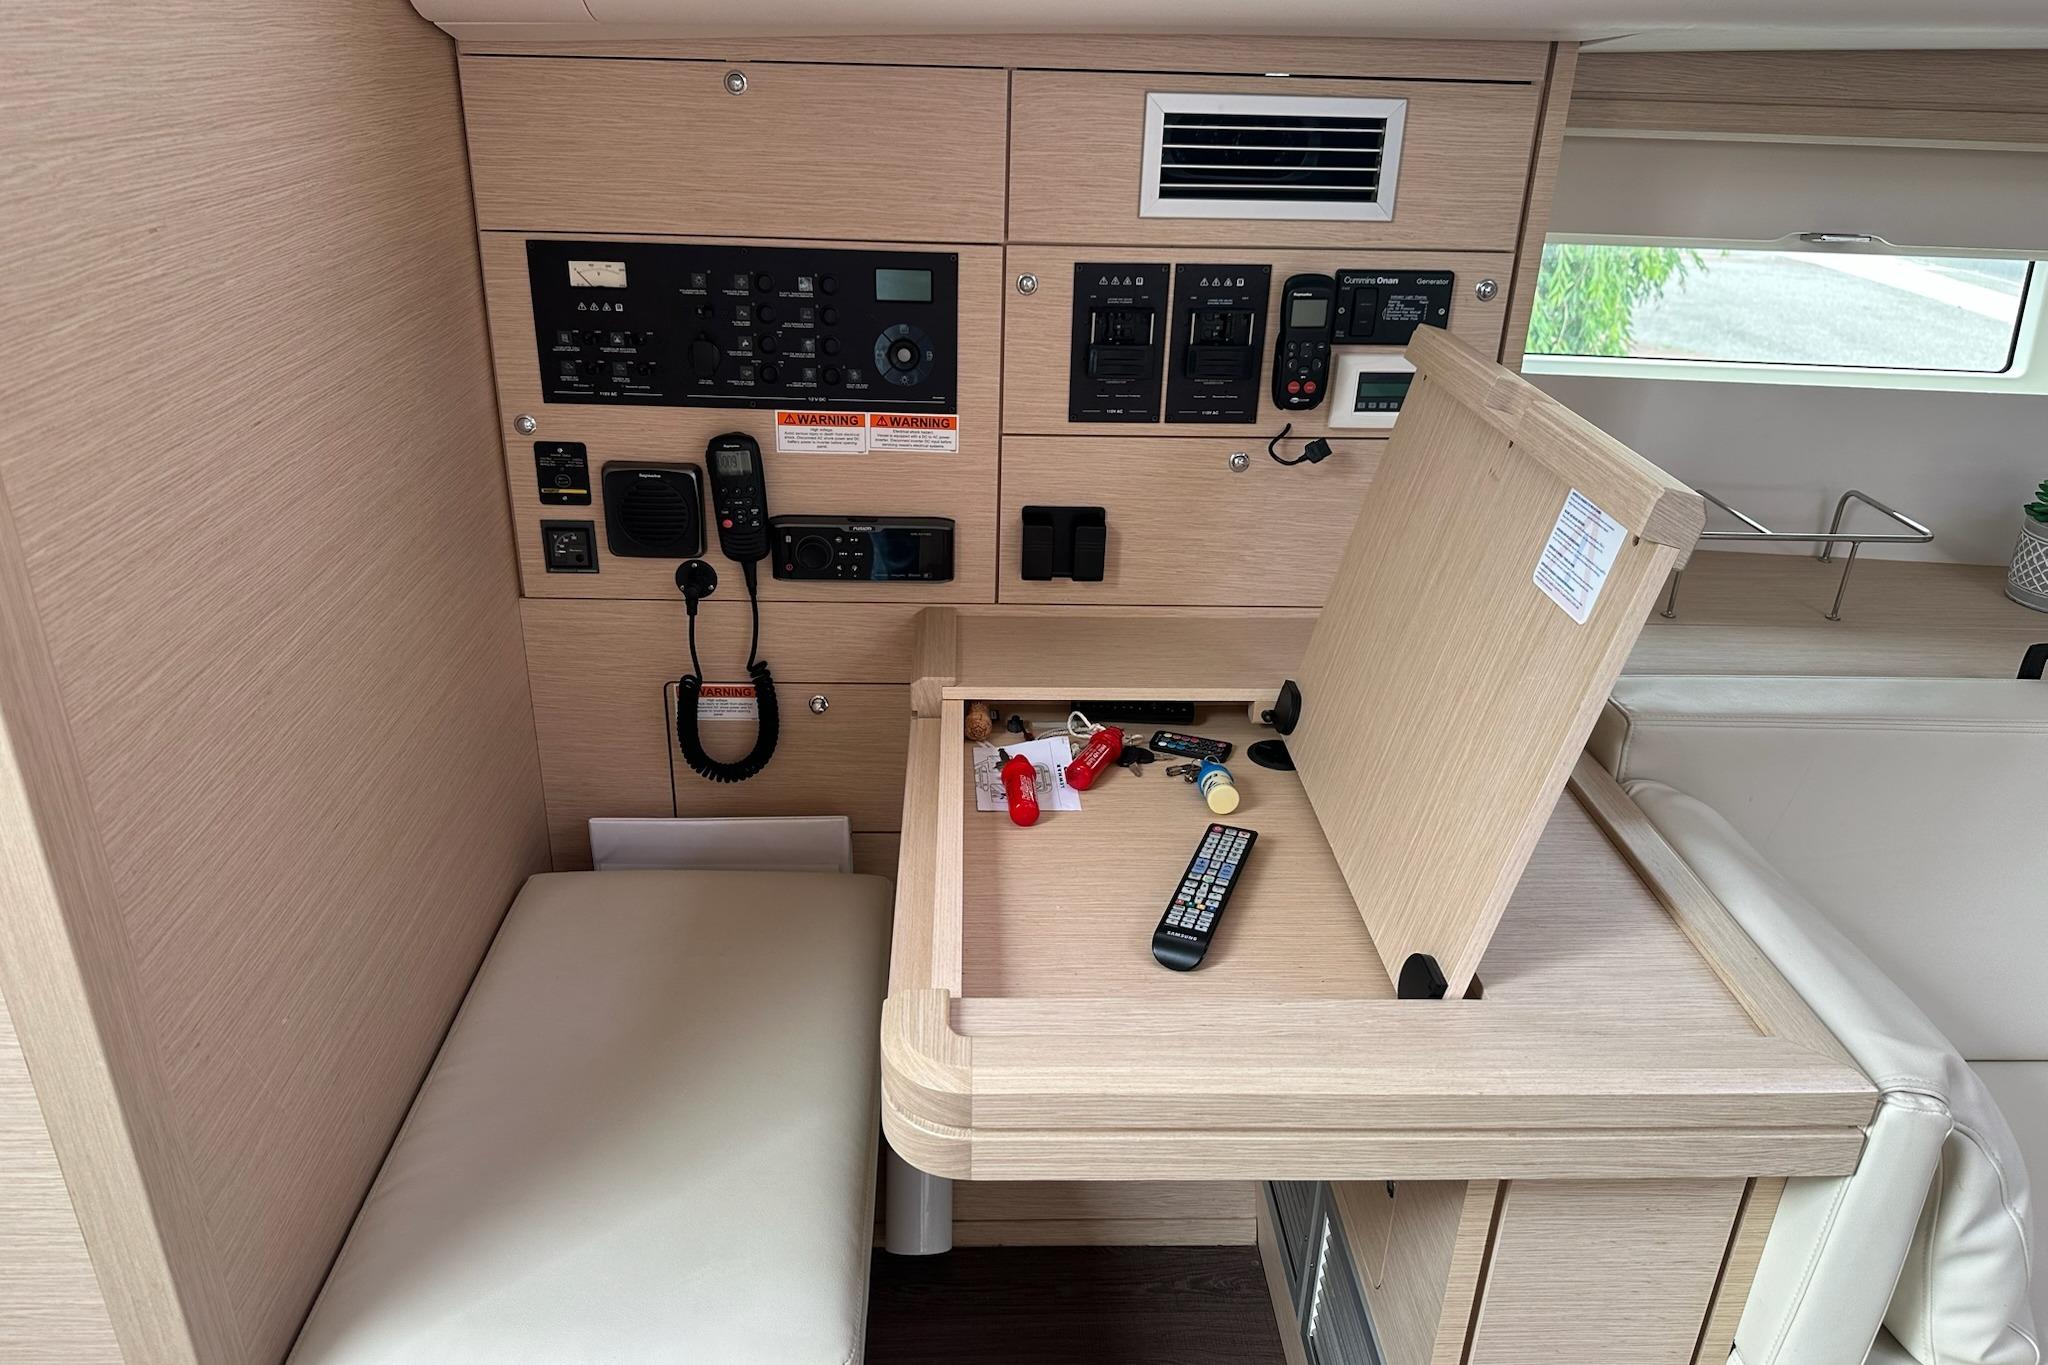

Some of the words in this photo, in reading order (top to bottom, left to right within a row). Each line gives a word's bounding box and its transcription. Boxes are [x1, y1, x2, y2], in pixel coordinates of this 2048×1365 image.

[1343, 276, 1376, 285] Cummins
[1377, 276, 1399, 285] Onan
[797, 414, 859, 426] WARNING
[890, 417, 950, 428] WARNING
[1166, 930, 1198, 941] SAMSUNG
